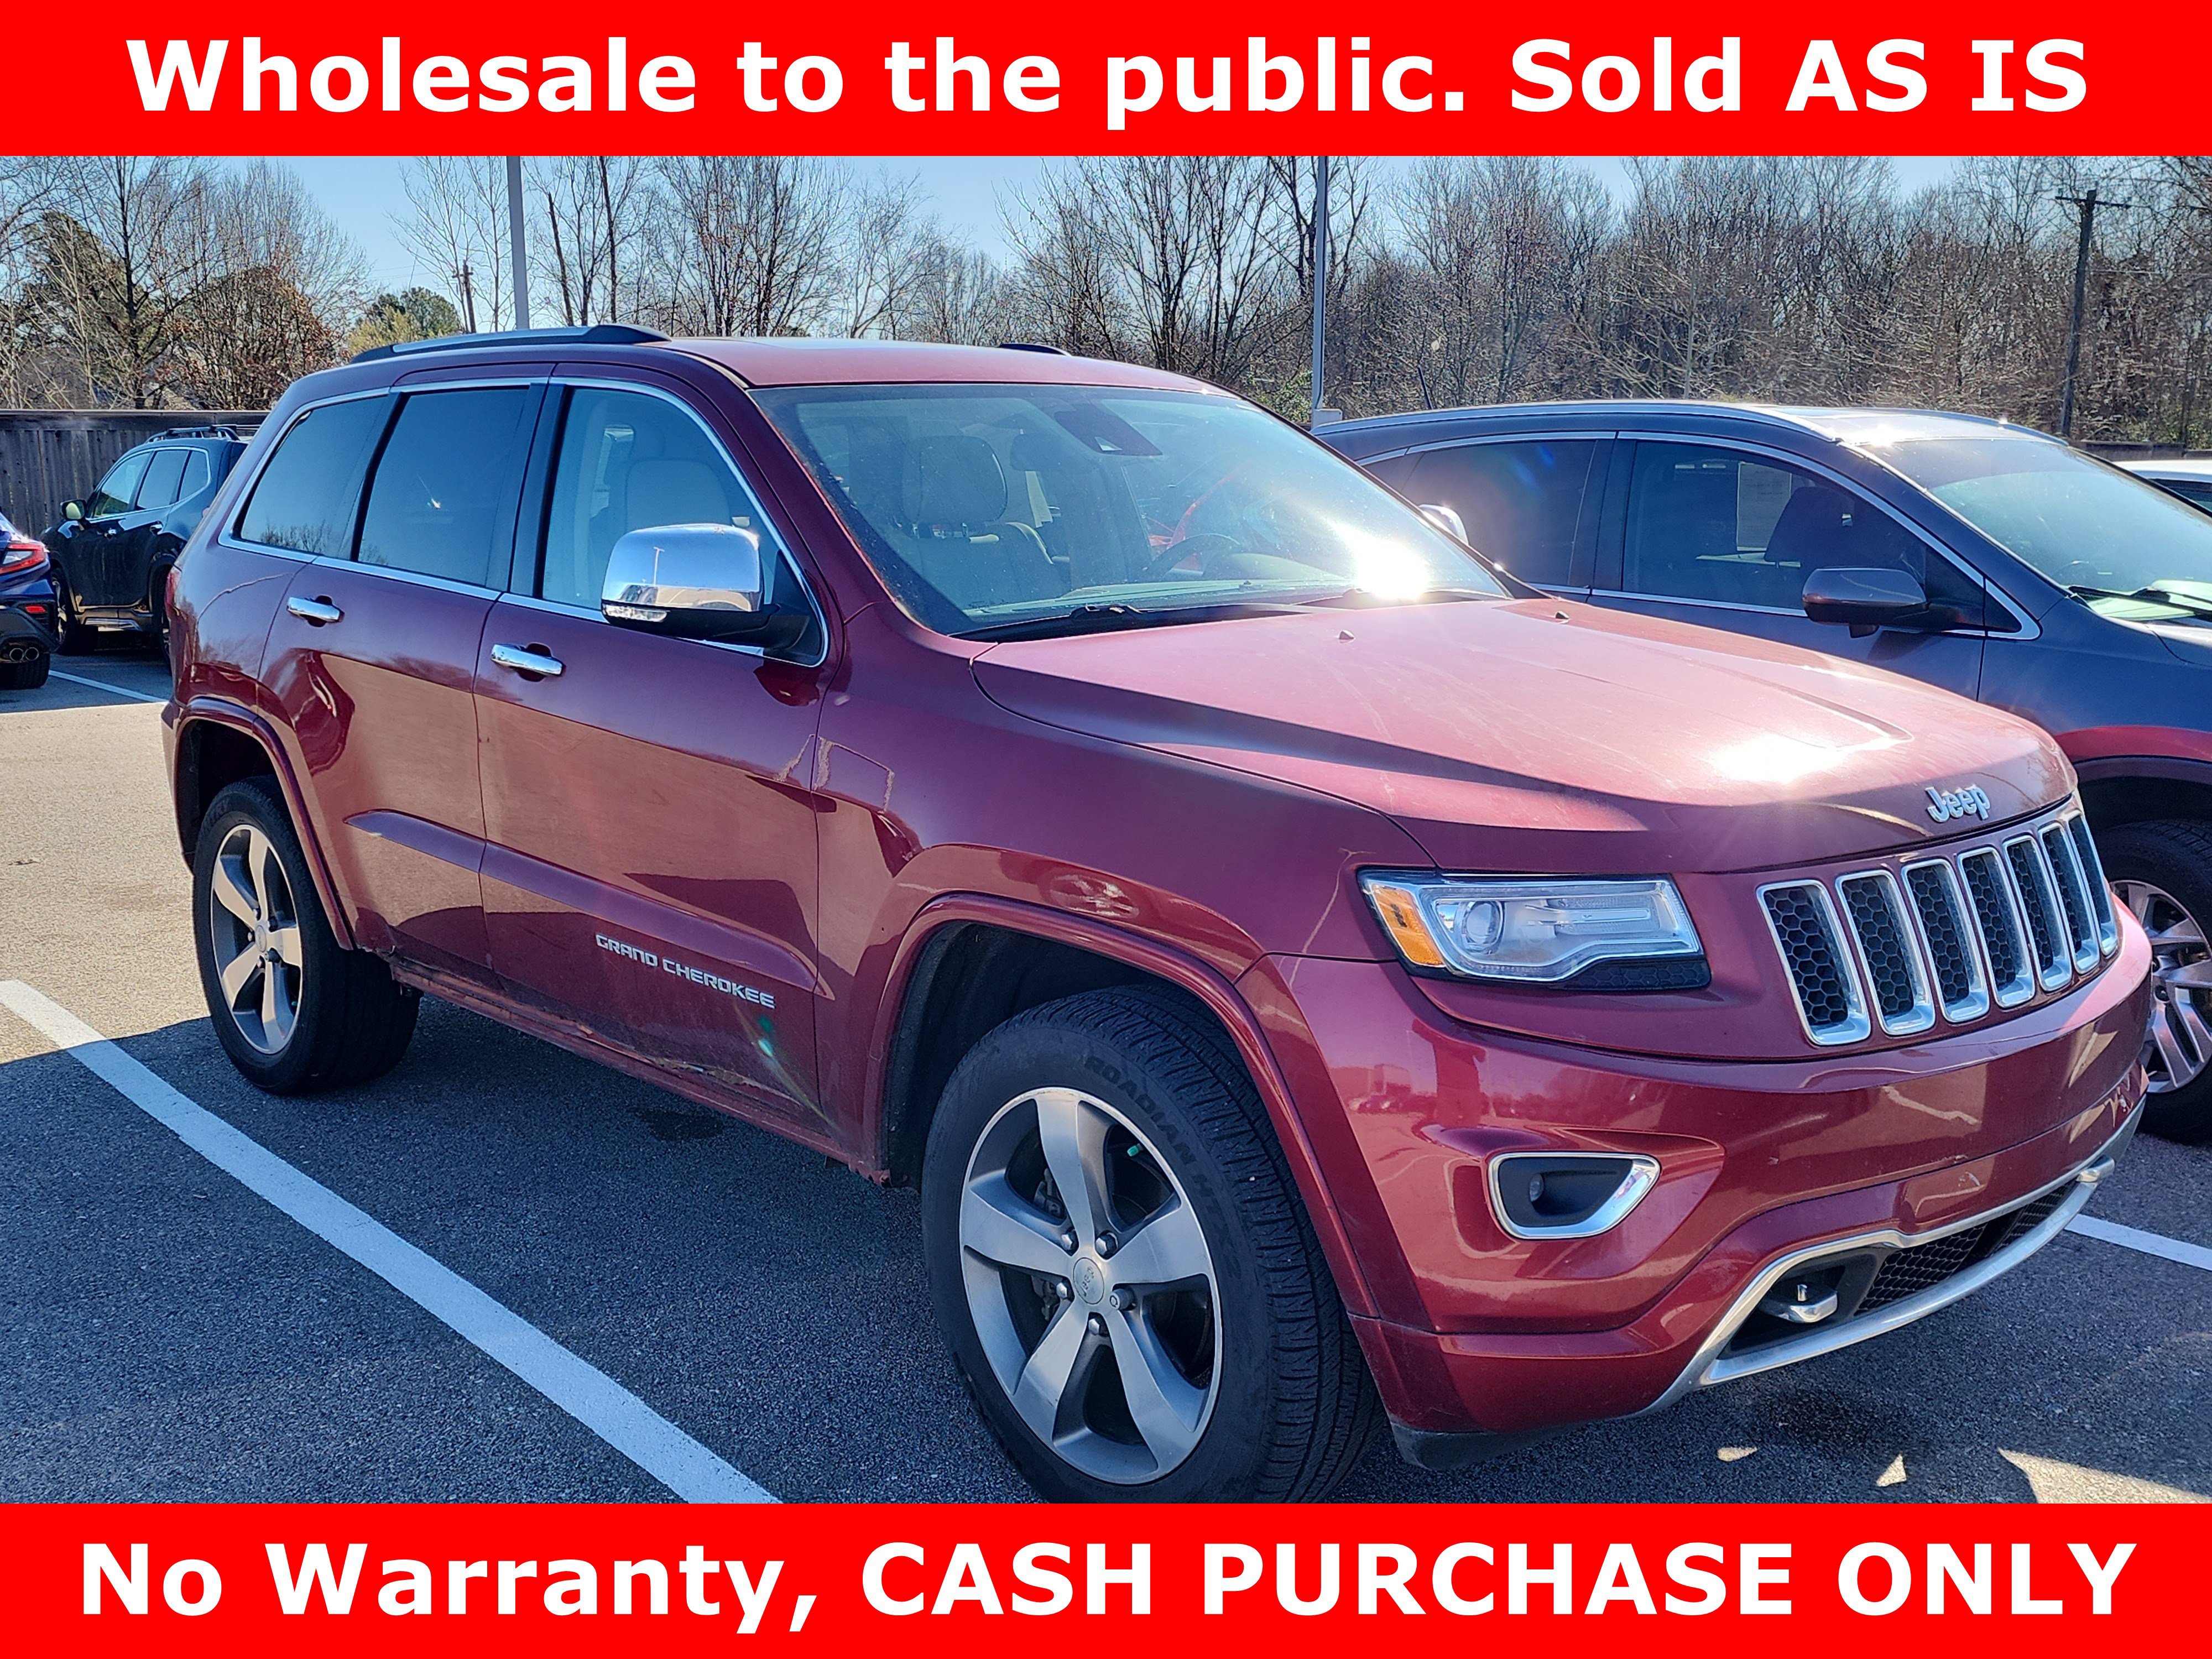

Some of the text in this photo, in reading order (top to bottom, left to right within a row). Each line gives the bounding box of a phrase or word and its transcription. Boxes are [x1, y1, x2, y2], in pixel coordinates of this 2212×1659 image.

[1924, 784, 1990, 823] Jeep
[596, 933, 776, 1009] GRAND CHEROKEE
[1084, 1055, 1197, 1166] ROADIAN
